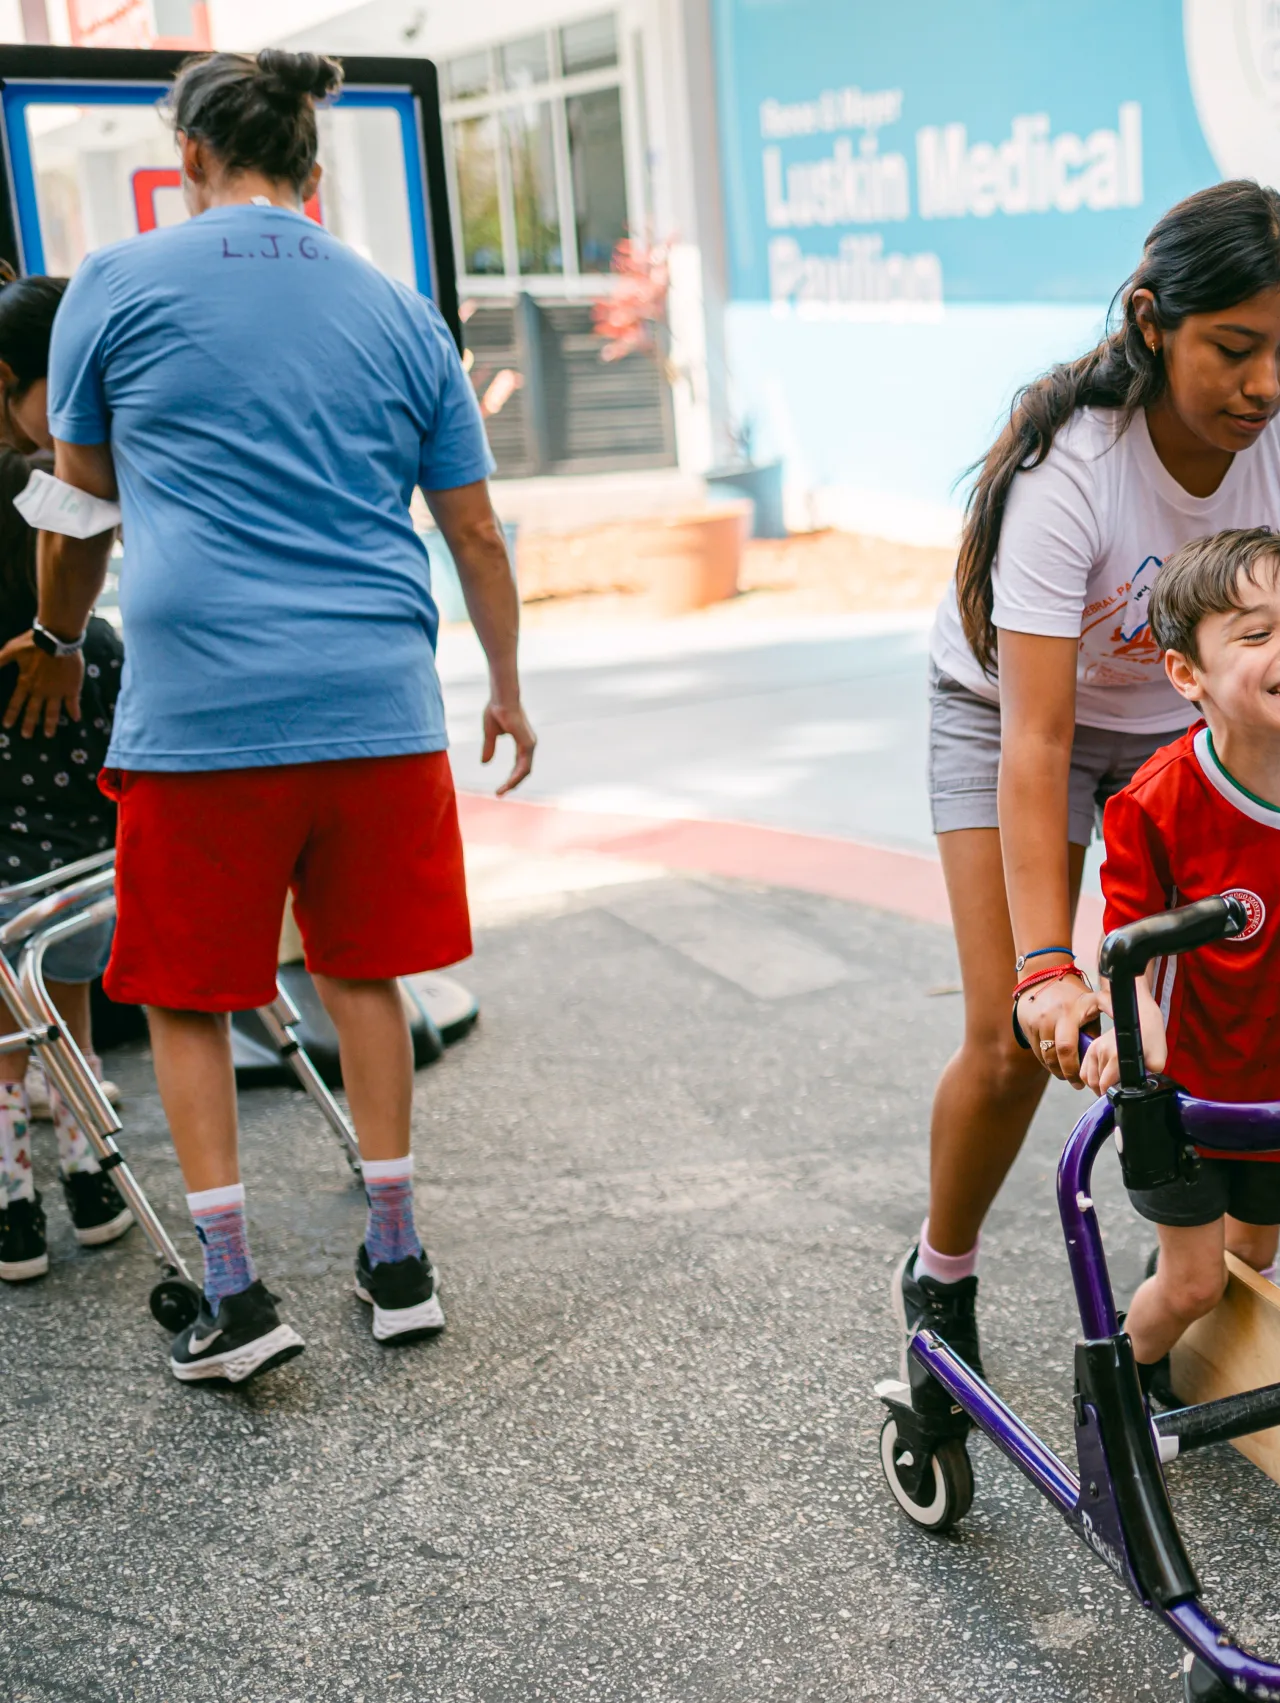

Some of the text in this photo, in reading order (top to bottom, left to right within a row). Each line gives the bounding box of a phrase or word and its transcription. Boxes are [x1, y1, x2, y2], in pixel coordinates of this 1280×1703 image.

[763, 101, 1143, 228] Luskin Medical
[768, 232, 945, 322] Pavilion
